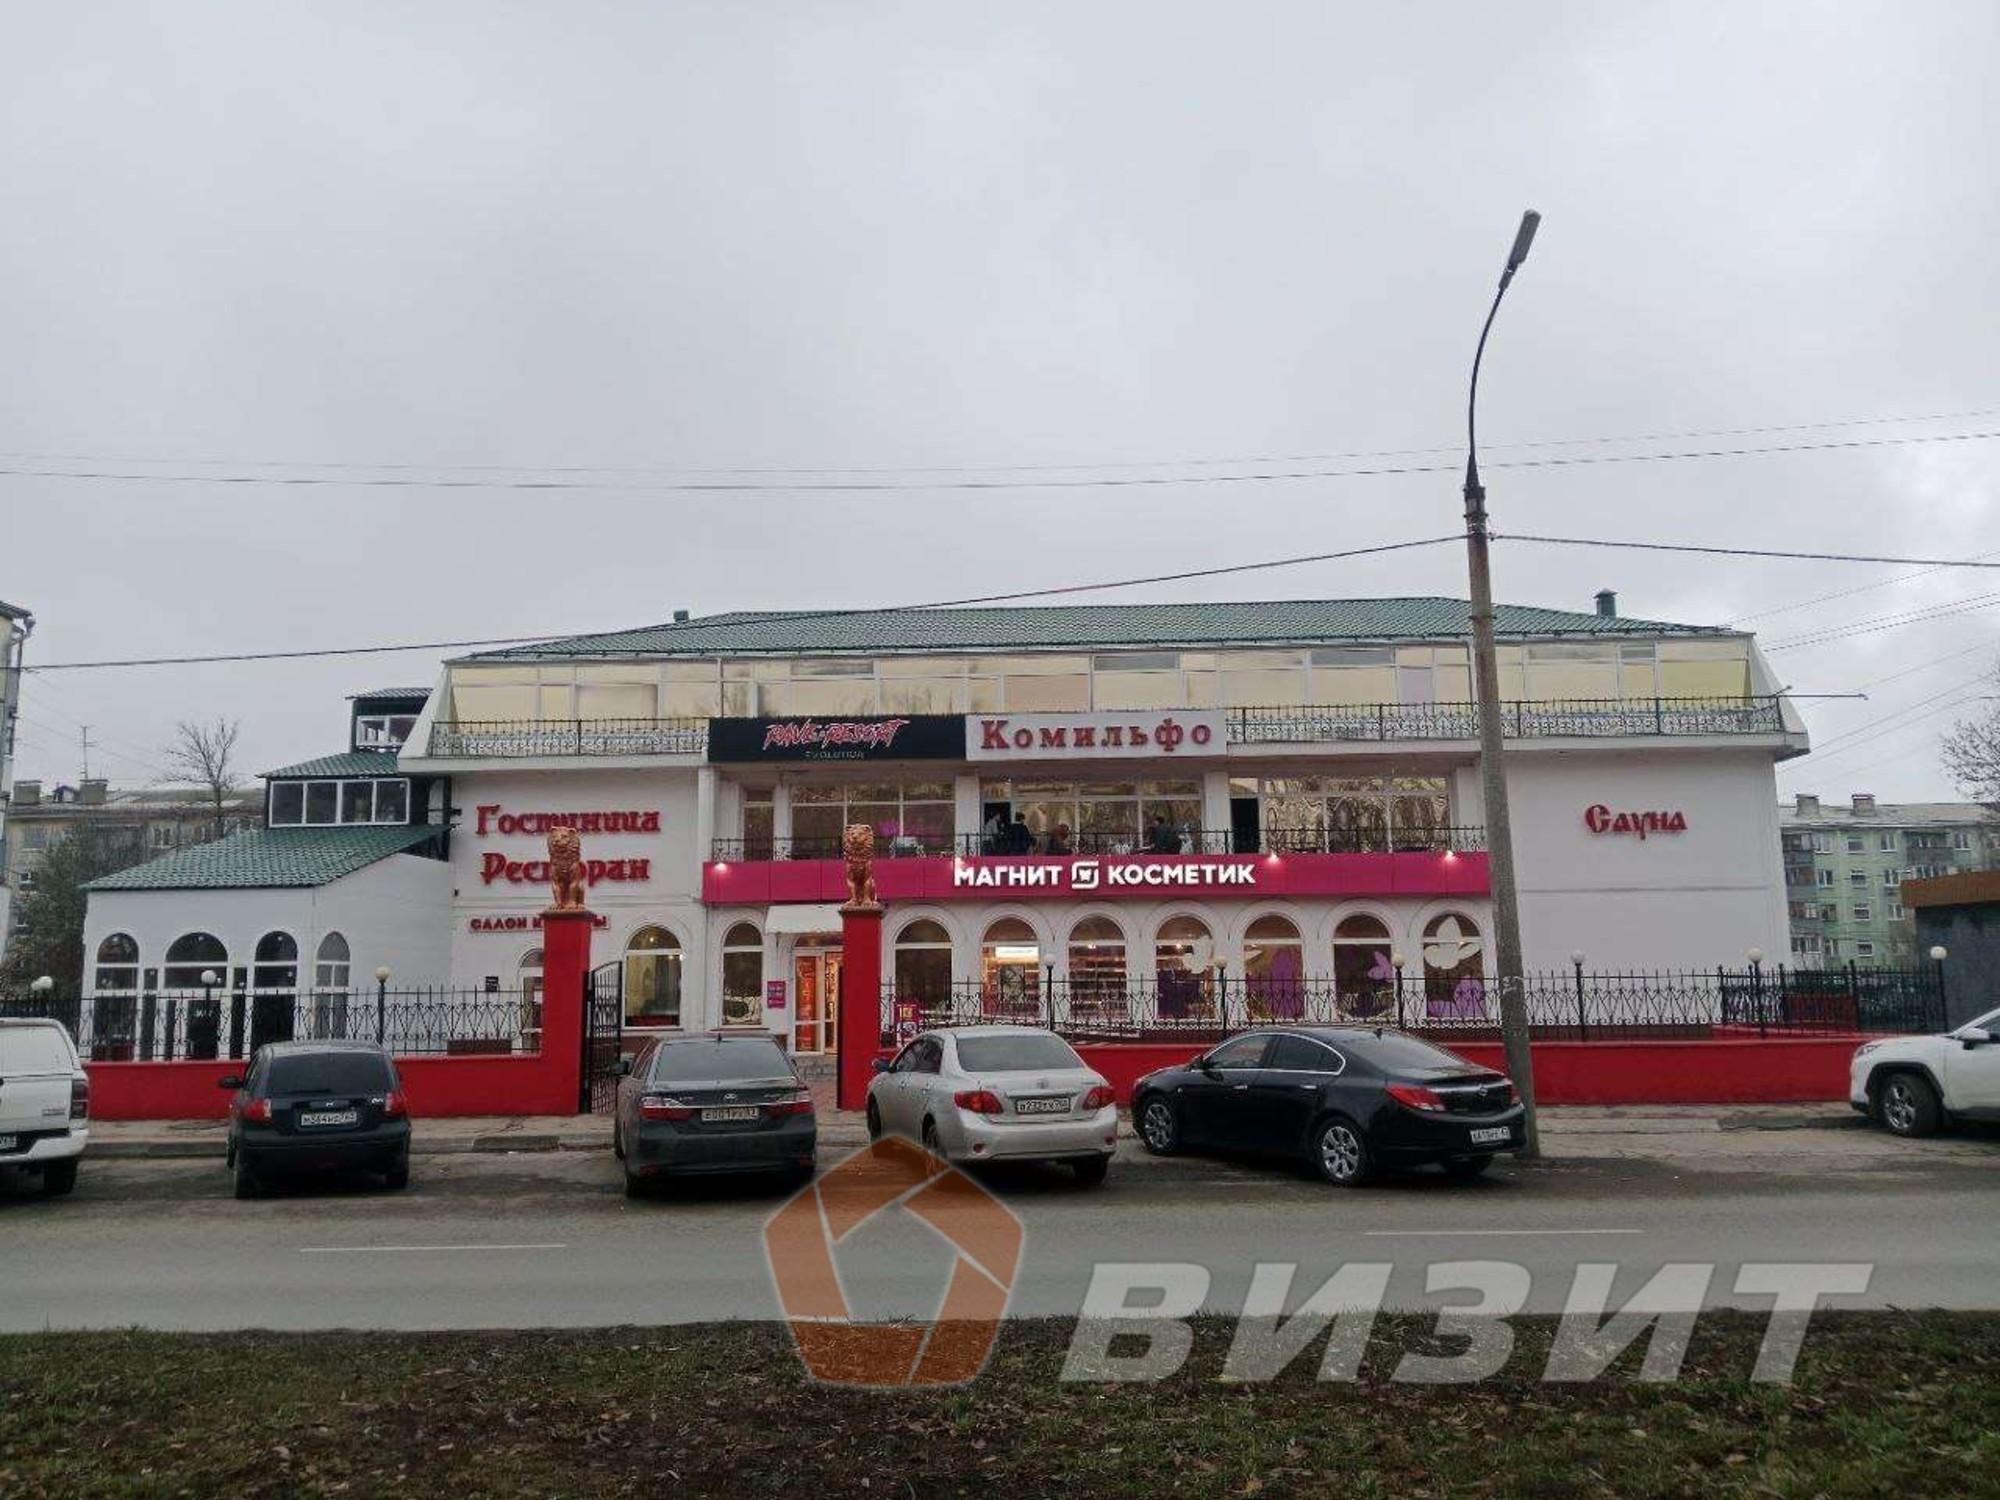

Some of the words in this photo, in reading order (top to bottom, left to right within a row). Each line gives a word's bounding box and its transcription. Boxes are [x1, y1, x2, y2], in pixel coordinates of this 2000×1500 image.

[980, 717, 1211, 752] Комильфо
[1585, 804, 1688, 840] Сауна
[954, 864, 1062, 887] МАГНИТ
[1107, 863, 1256, 885] КОСМЕТИК
[470, 916, 527, 930] САЛОН
